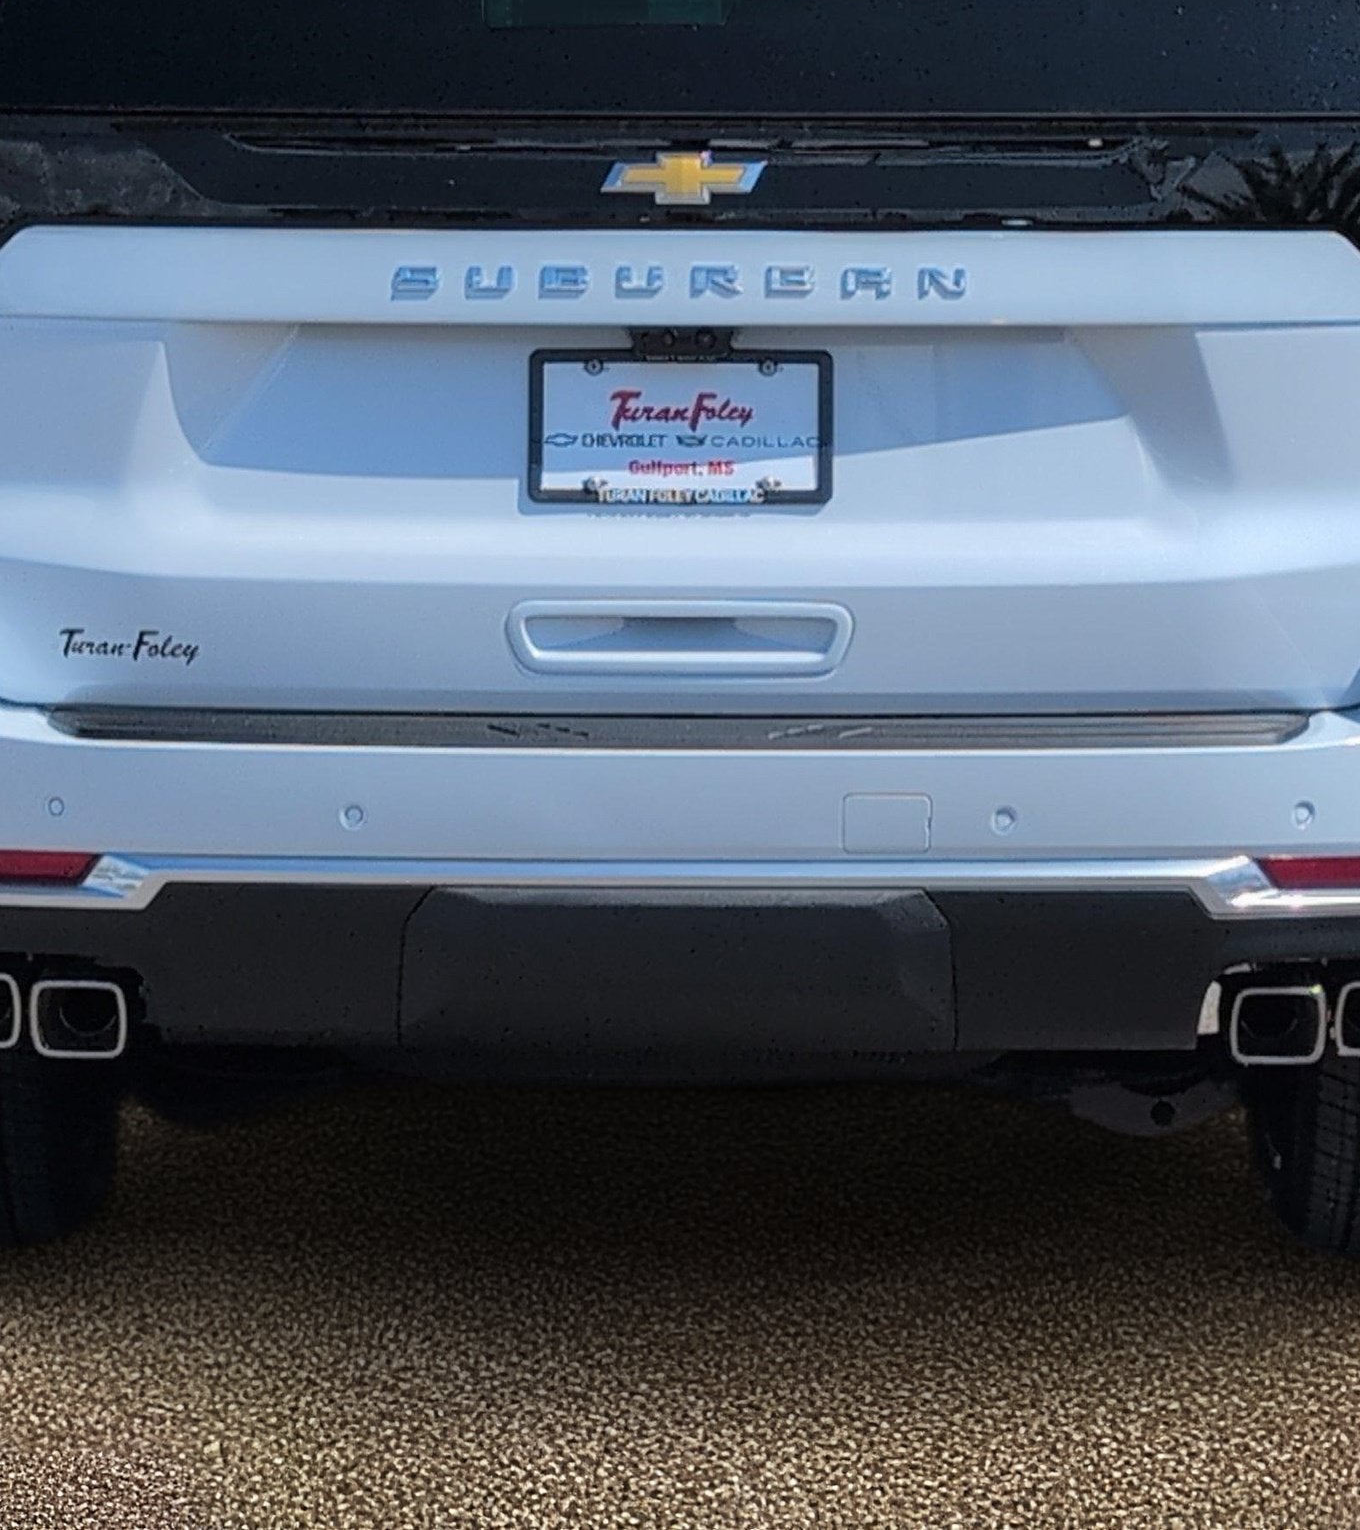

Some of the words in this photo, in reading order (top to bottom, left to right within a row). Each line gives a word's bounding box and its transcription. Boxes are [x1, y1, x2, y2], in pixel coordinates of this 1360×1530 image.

[581, 433, 668, 448] CHEVROLET
[711, 436, 822, 448] CADILLAC
[708, 460, 734, 476] MS
